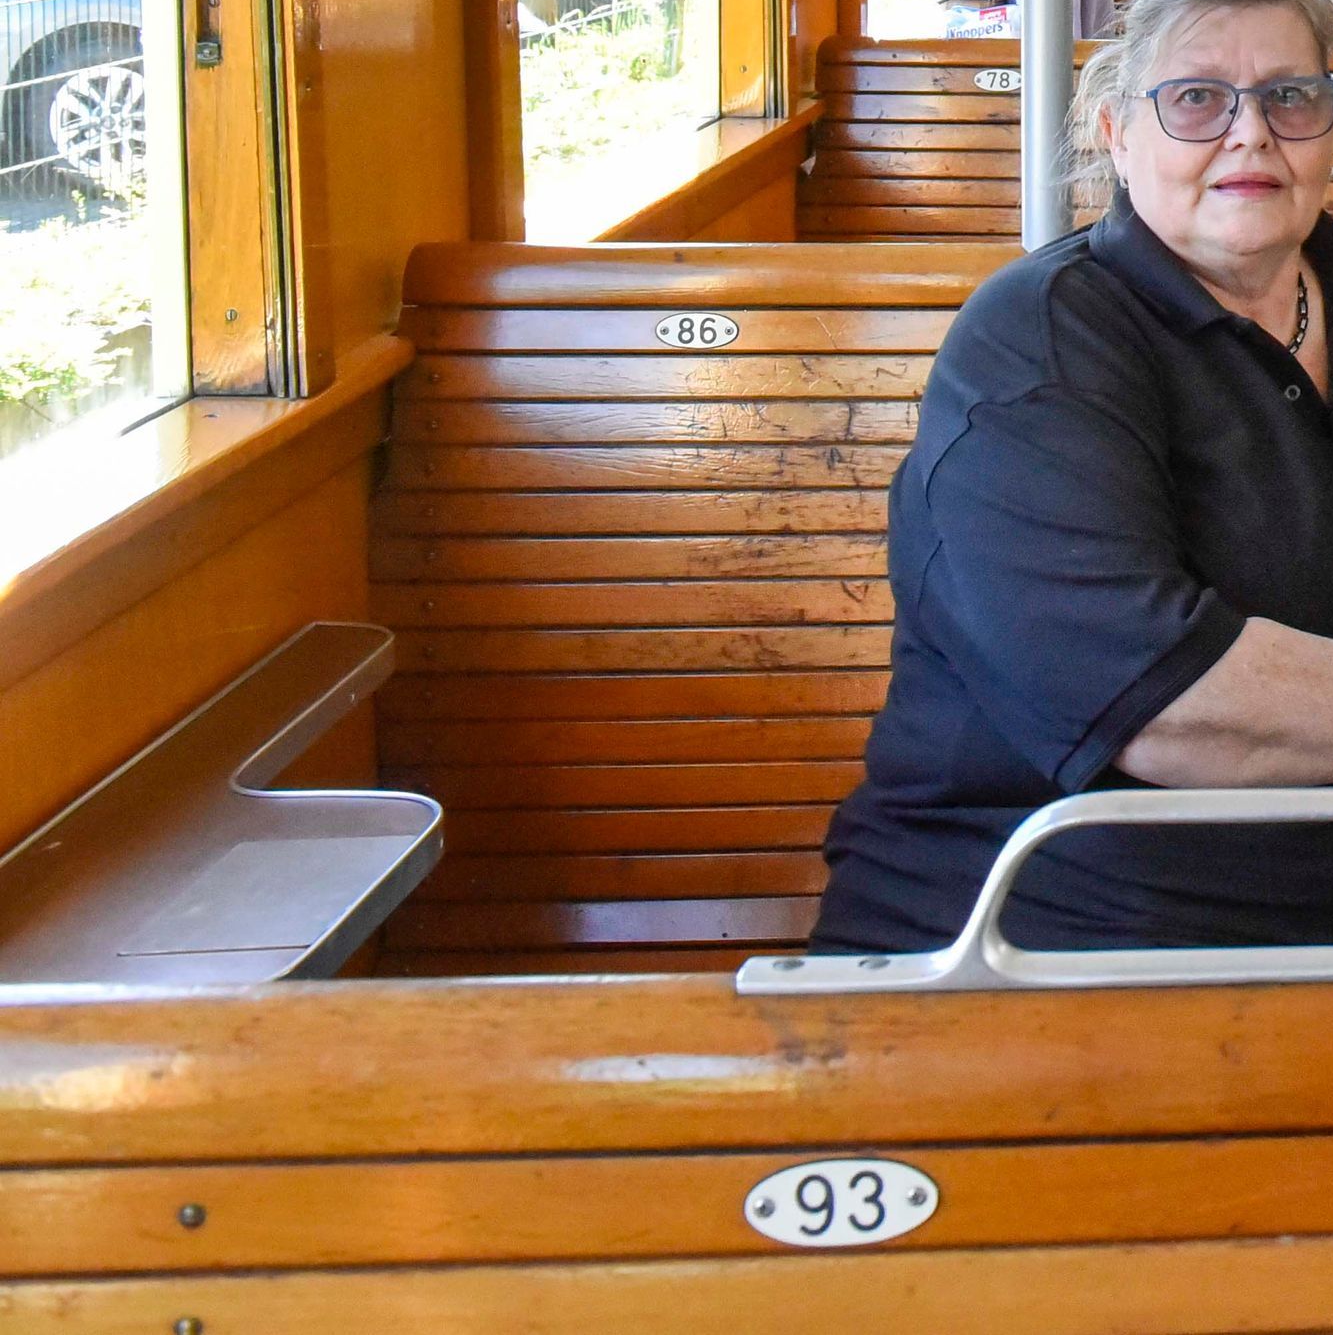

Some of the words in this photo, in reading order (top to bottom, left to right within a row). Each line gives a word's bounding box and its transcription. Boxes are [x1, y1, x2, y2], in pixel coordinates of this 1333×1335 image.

[986, 72, 1011, 89] 78
[677, 317, 718, 345] 86
[796, 1170, 886, 1237] 93
